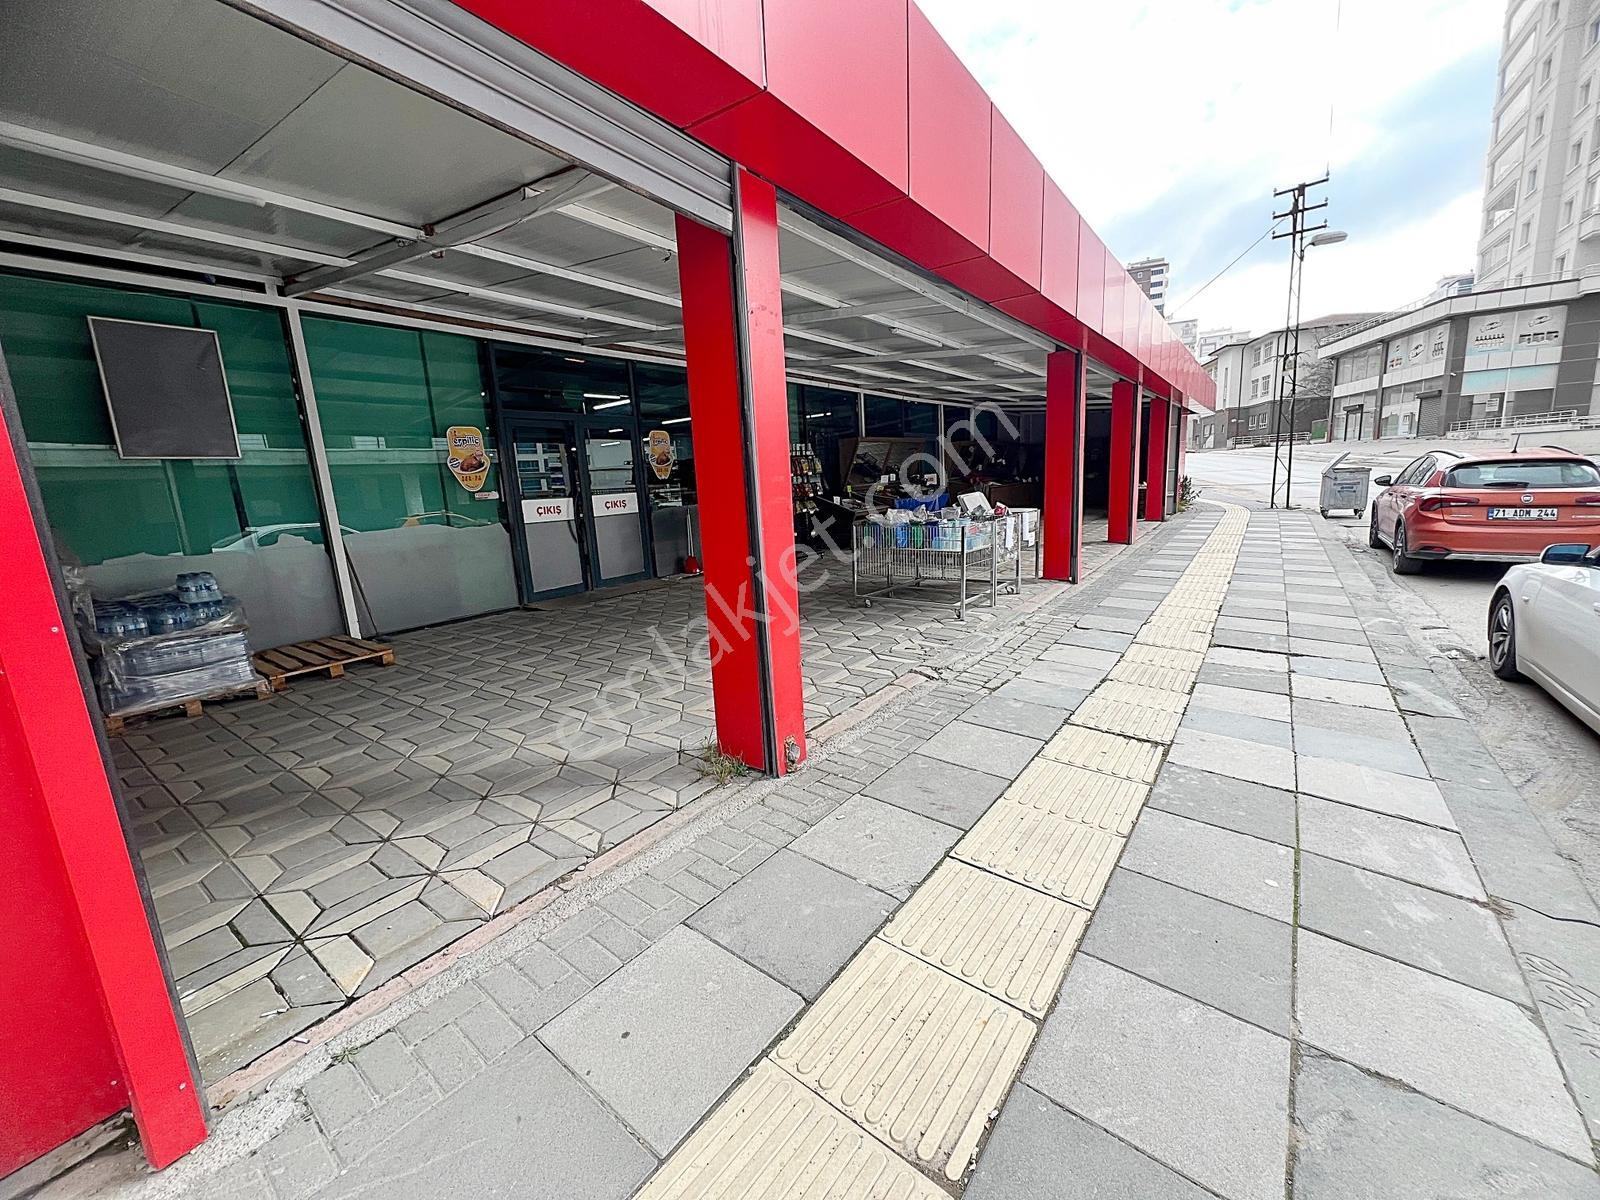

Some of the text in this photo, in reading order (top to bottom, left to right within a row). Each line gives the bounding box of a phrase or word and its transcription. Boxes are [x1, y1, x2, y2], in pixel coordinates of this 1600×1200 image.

[604, 499, 627, 510] ÇIKIŞ
[536, 505, 562, 517] ÇIKIŞ
[1494, 508, 1556, 518] 71 ADM 244
